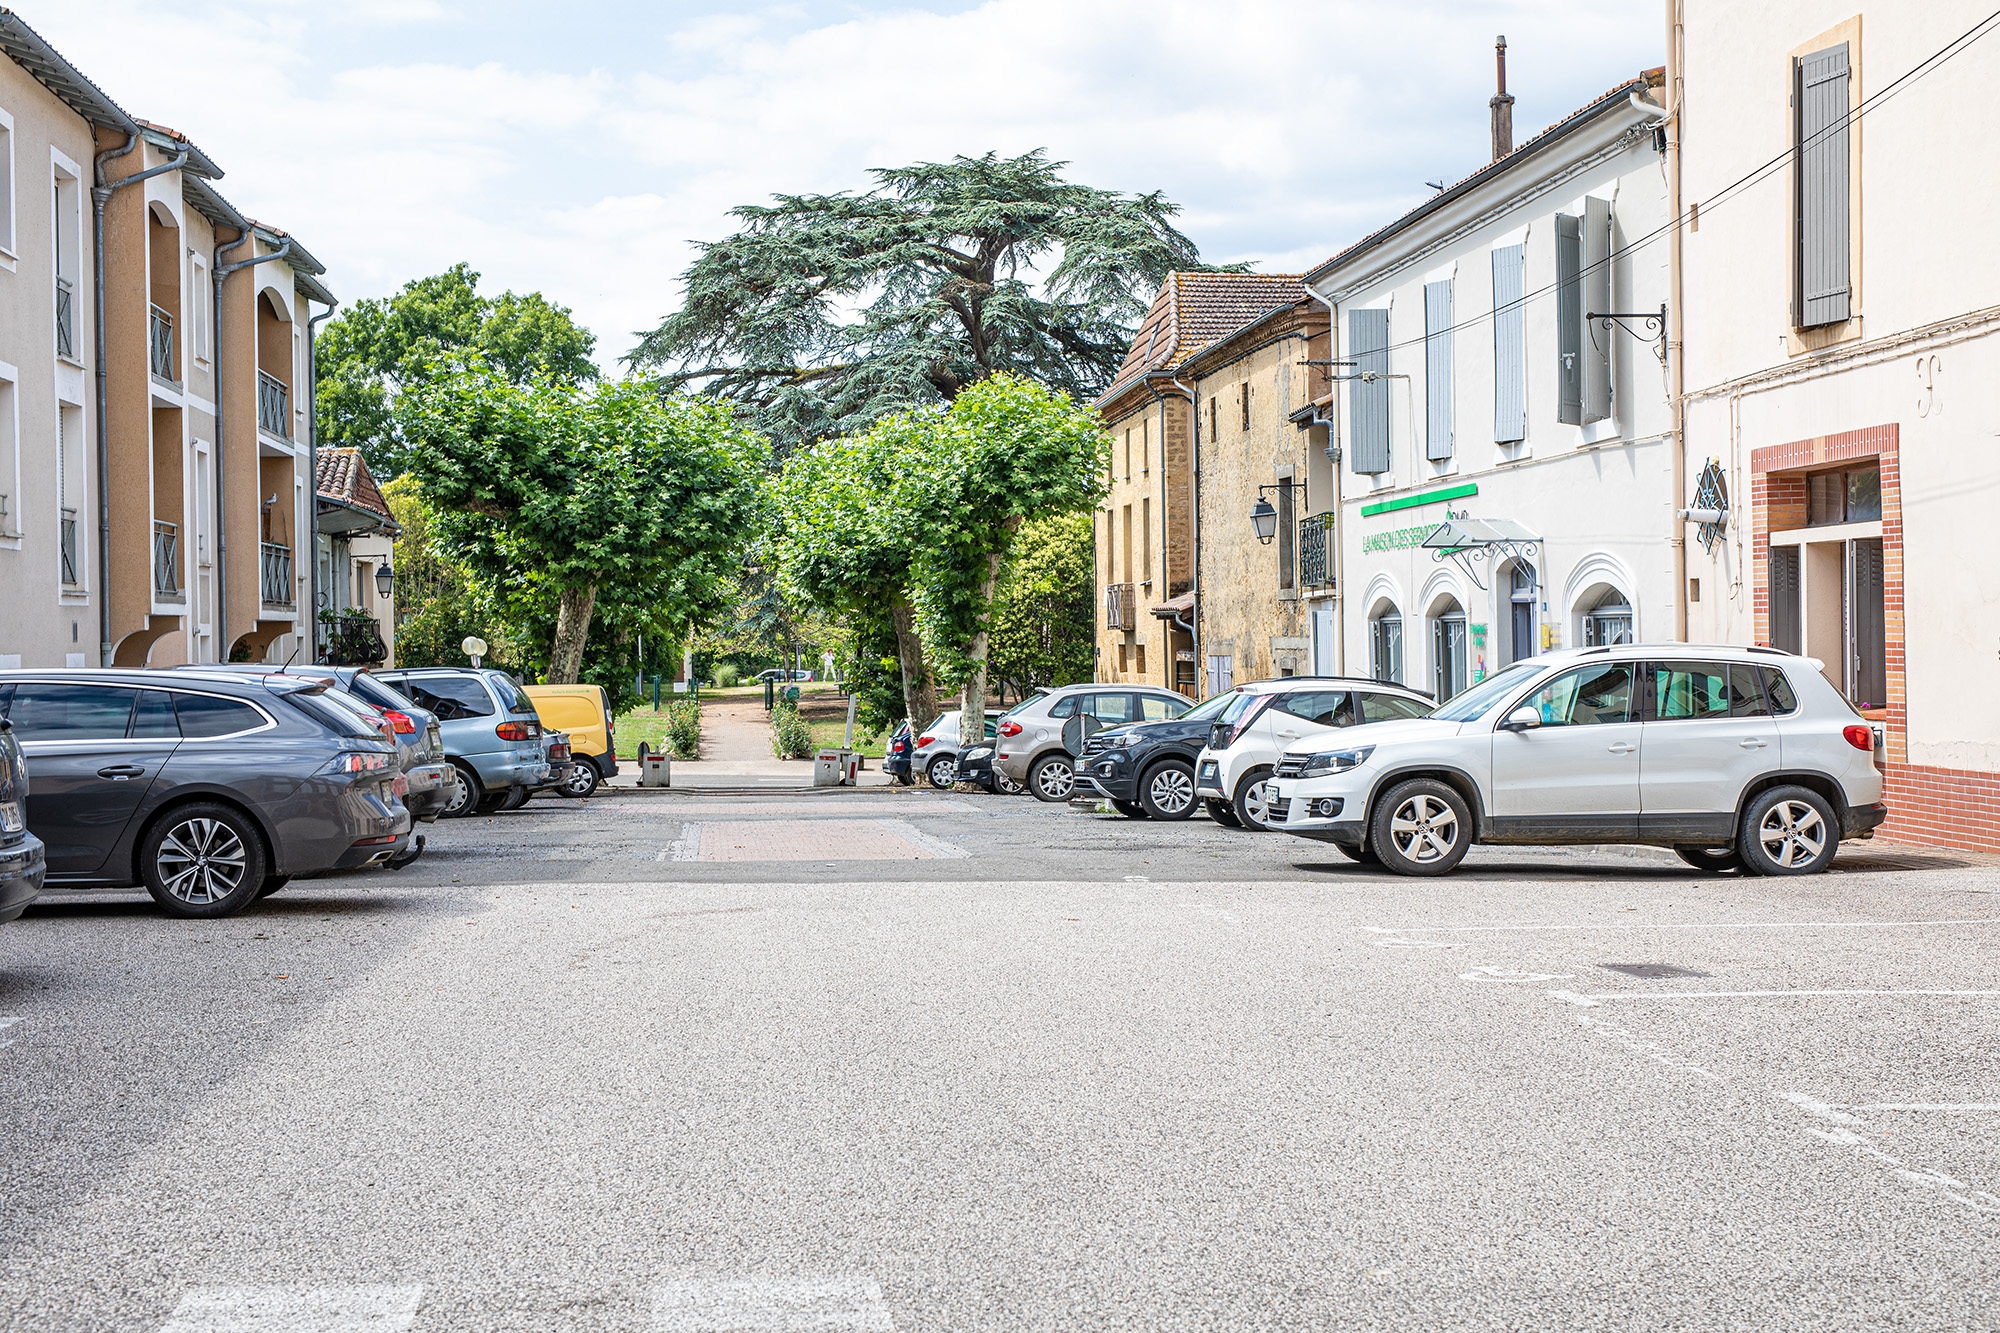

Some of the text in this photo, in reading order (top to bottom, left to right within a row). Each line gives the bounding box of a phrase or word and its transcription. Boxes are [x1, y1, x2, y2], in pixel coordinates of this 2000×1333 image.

[1363, 535, 1370, 553] LA
[1371, 531, 1394, 551] MAISON
[1395, 528, 1407, 548] DES
